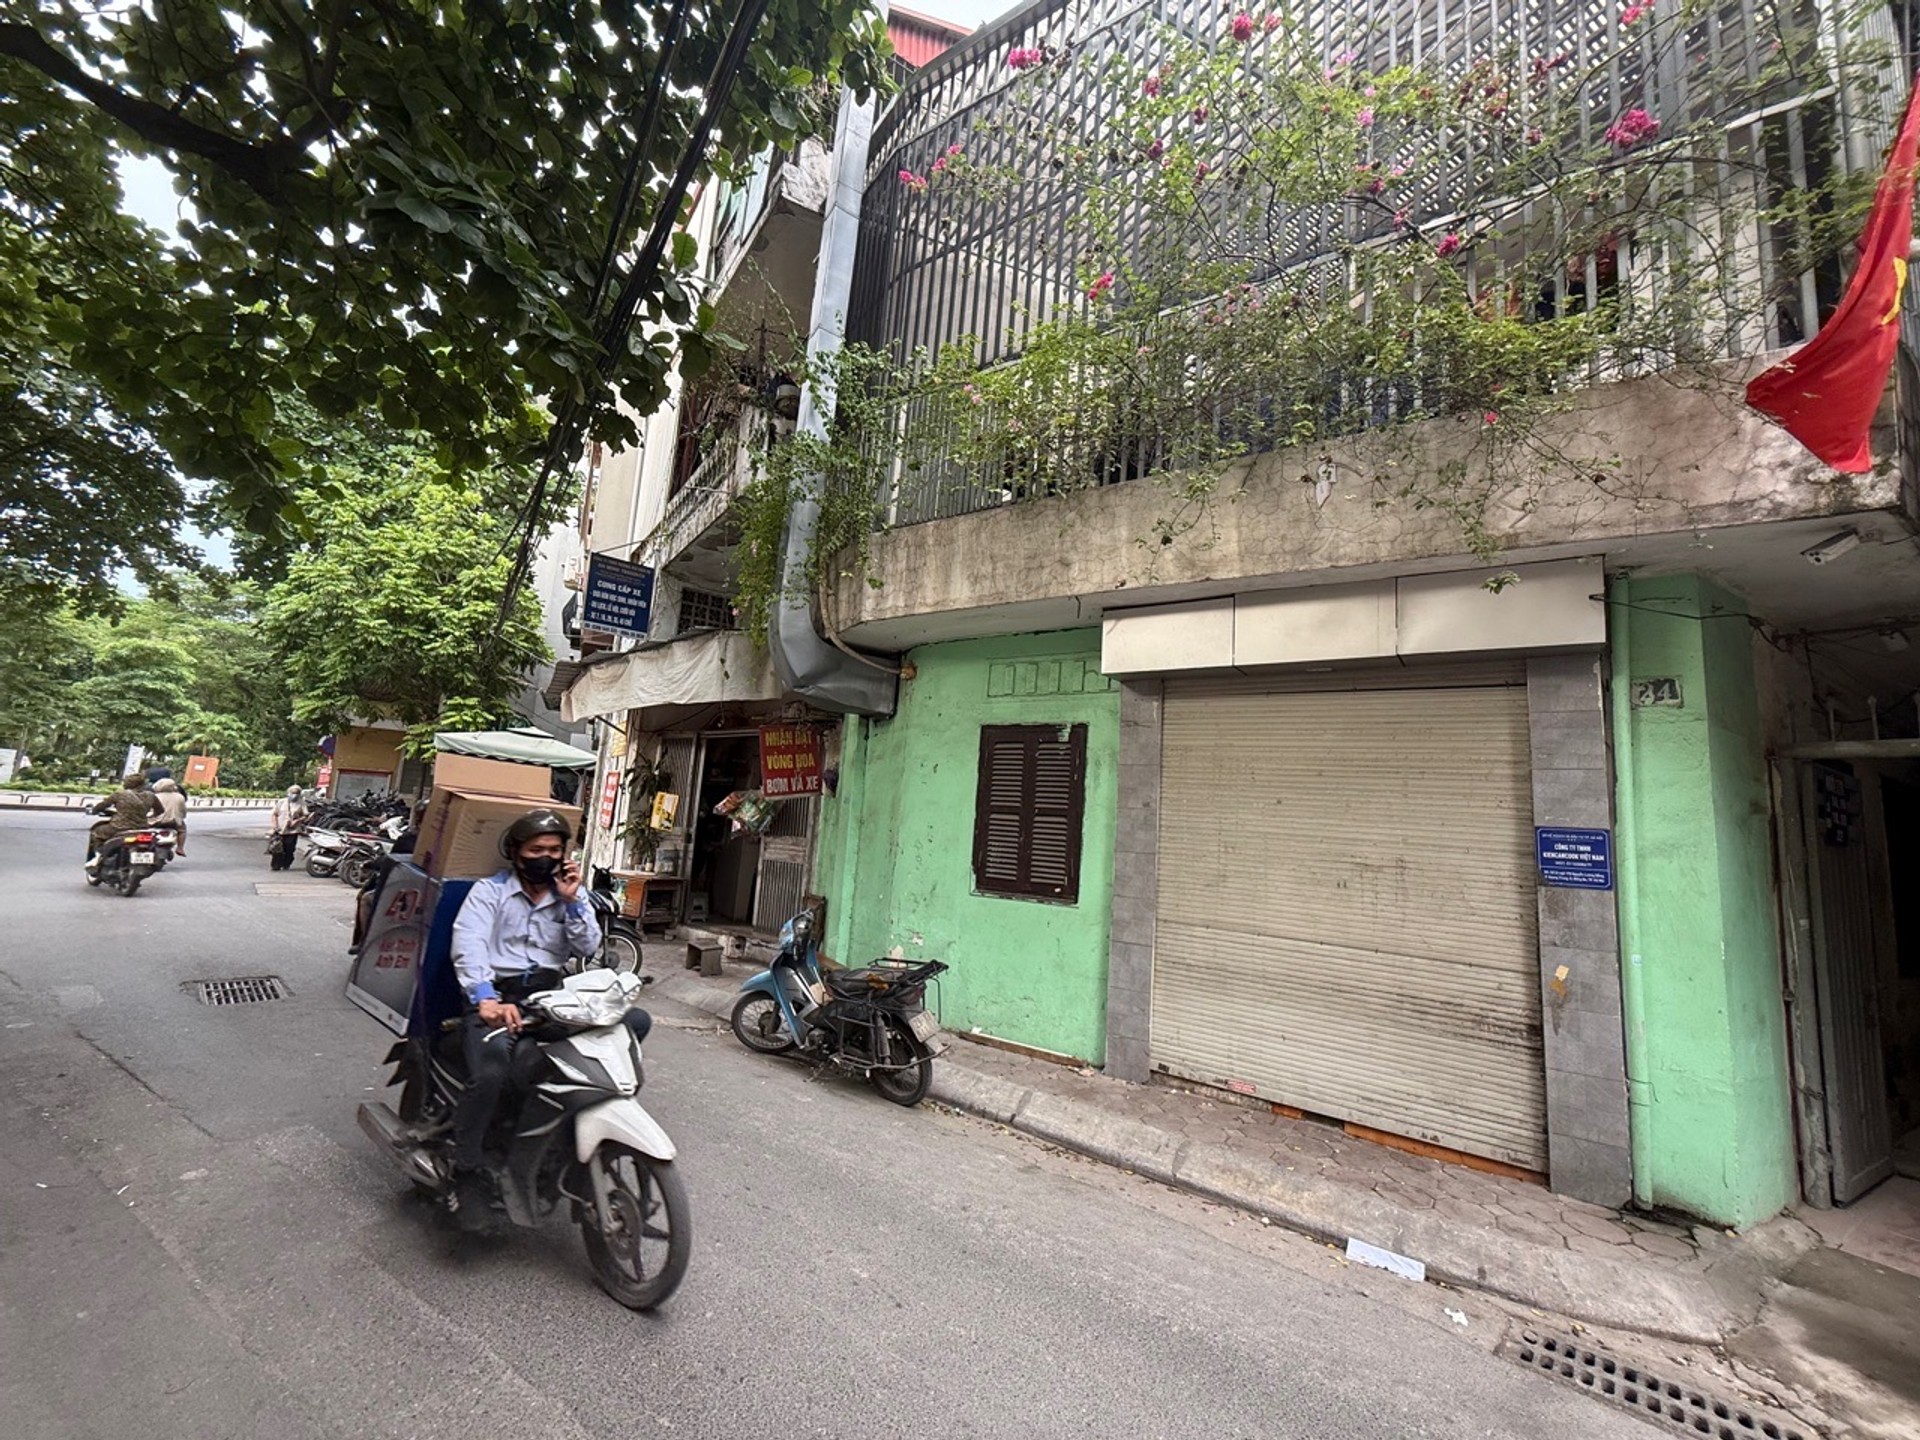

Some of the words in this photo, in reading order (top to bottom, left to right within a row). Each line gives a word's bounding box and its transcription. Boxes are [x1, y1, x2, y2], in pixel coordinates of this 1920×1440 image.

[765, 728, 793, 748] NHẬN
[766, 751, 793, 769] VÒNG
[795, 753, 815, 768] HOA
[766, 777, 789, 793] BƠM
[806, 775, 819, 790] XE
[1554, 843, 1568, 851] CÔNG
